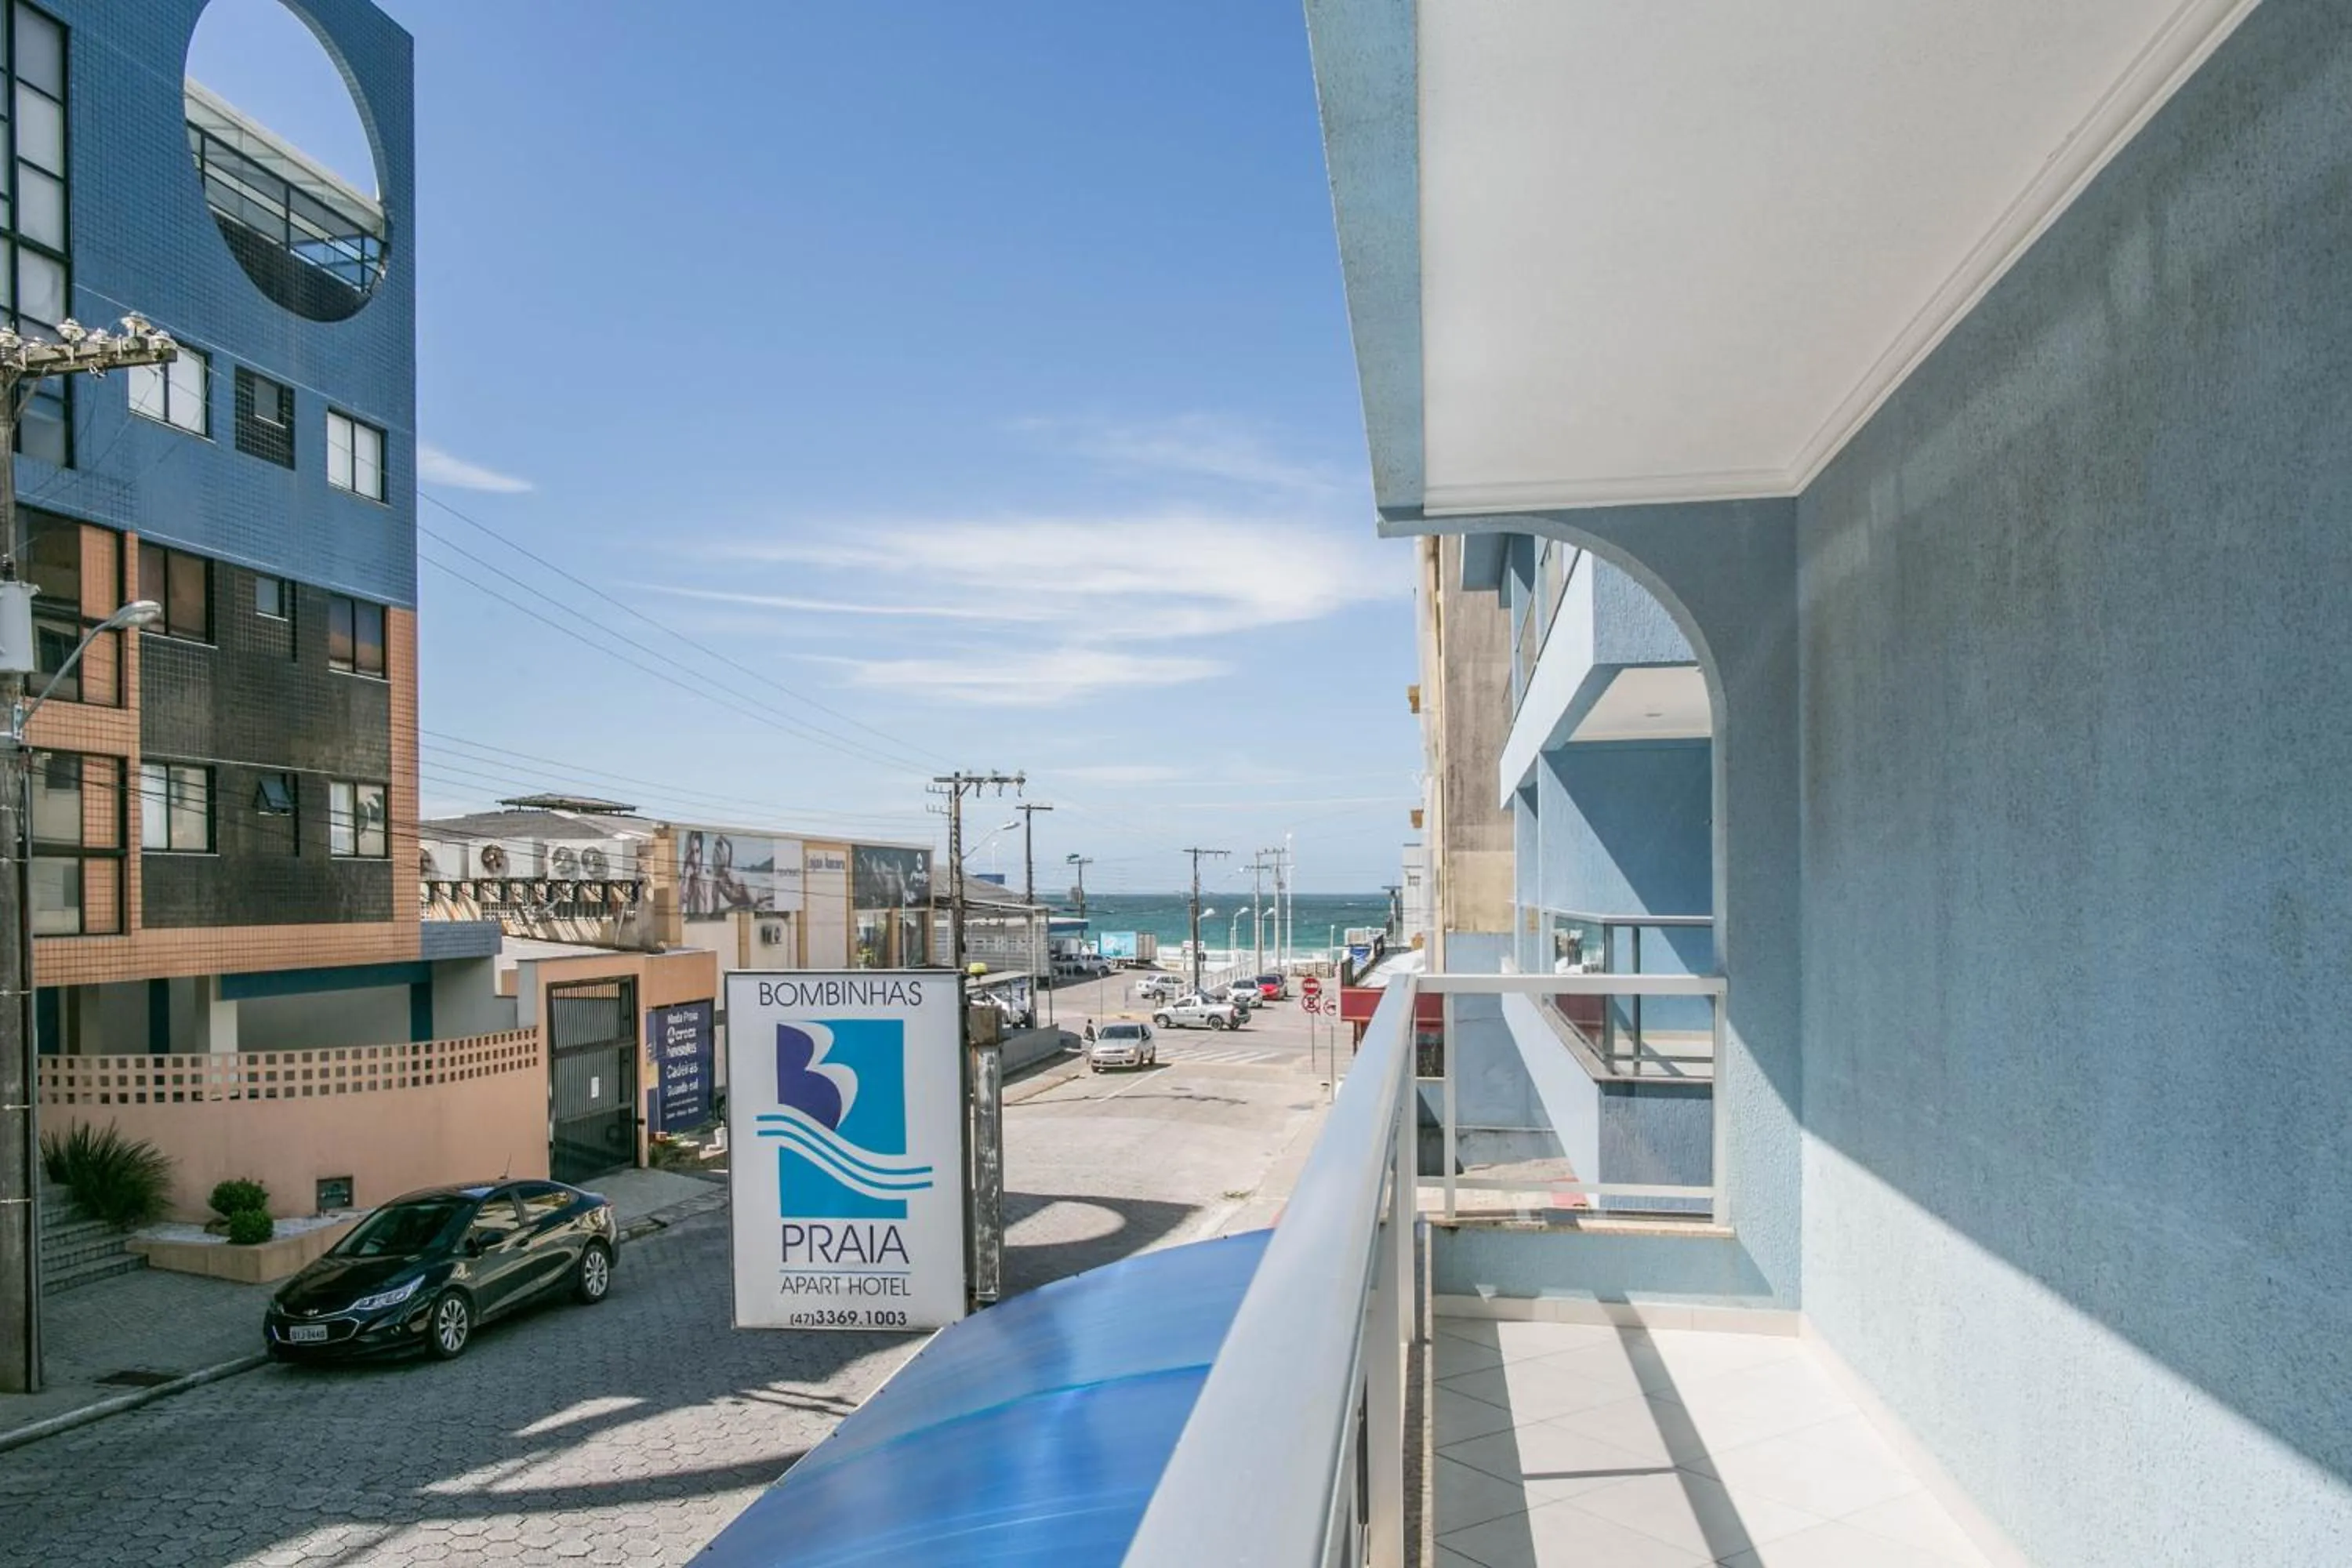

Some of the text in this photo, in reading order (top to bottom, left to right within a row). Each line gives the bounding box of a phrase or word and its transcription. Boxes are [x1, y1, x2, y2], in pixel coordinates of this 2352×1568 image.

[758, 981, 923, 1007] BOMBINHAS
[782, 1224, 910, 1265] PRAIA
[780, 1276, 913, 1296] APART HOTEL
